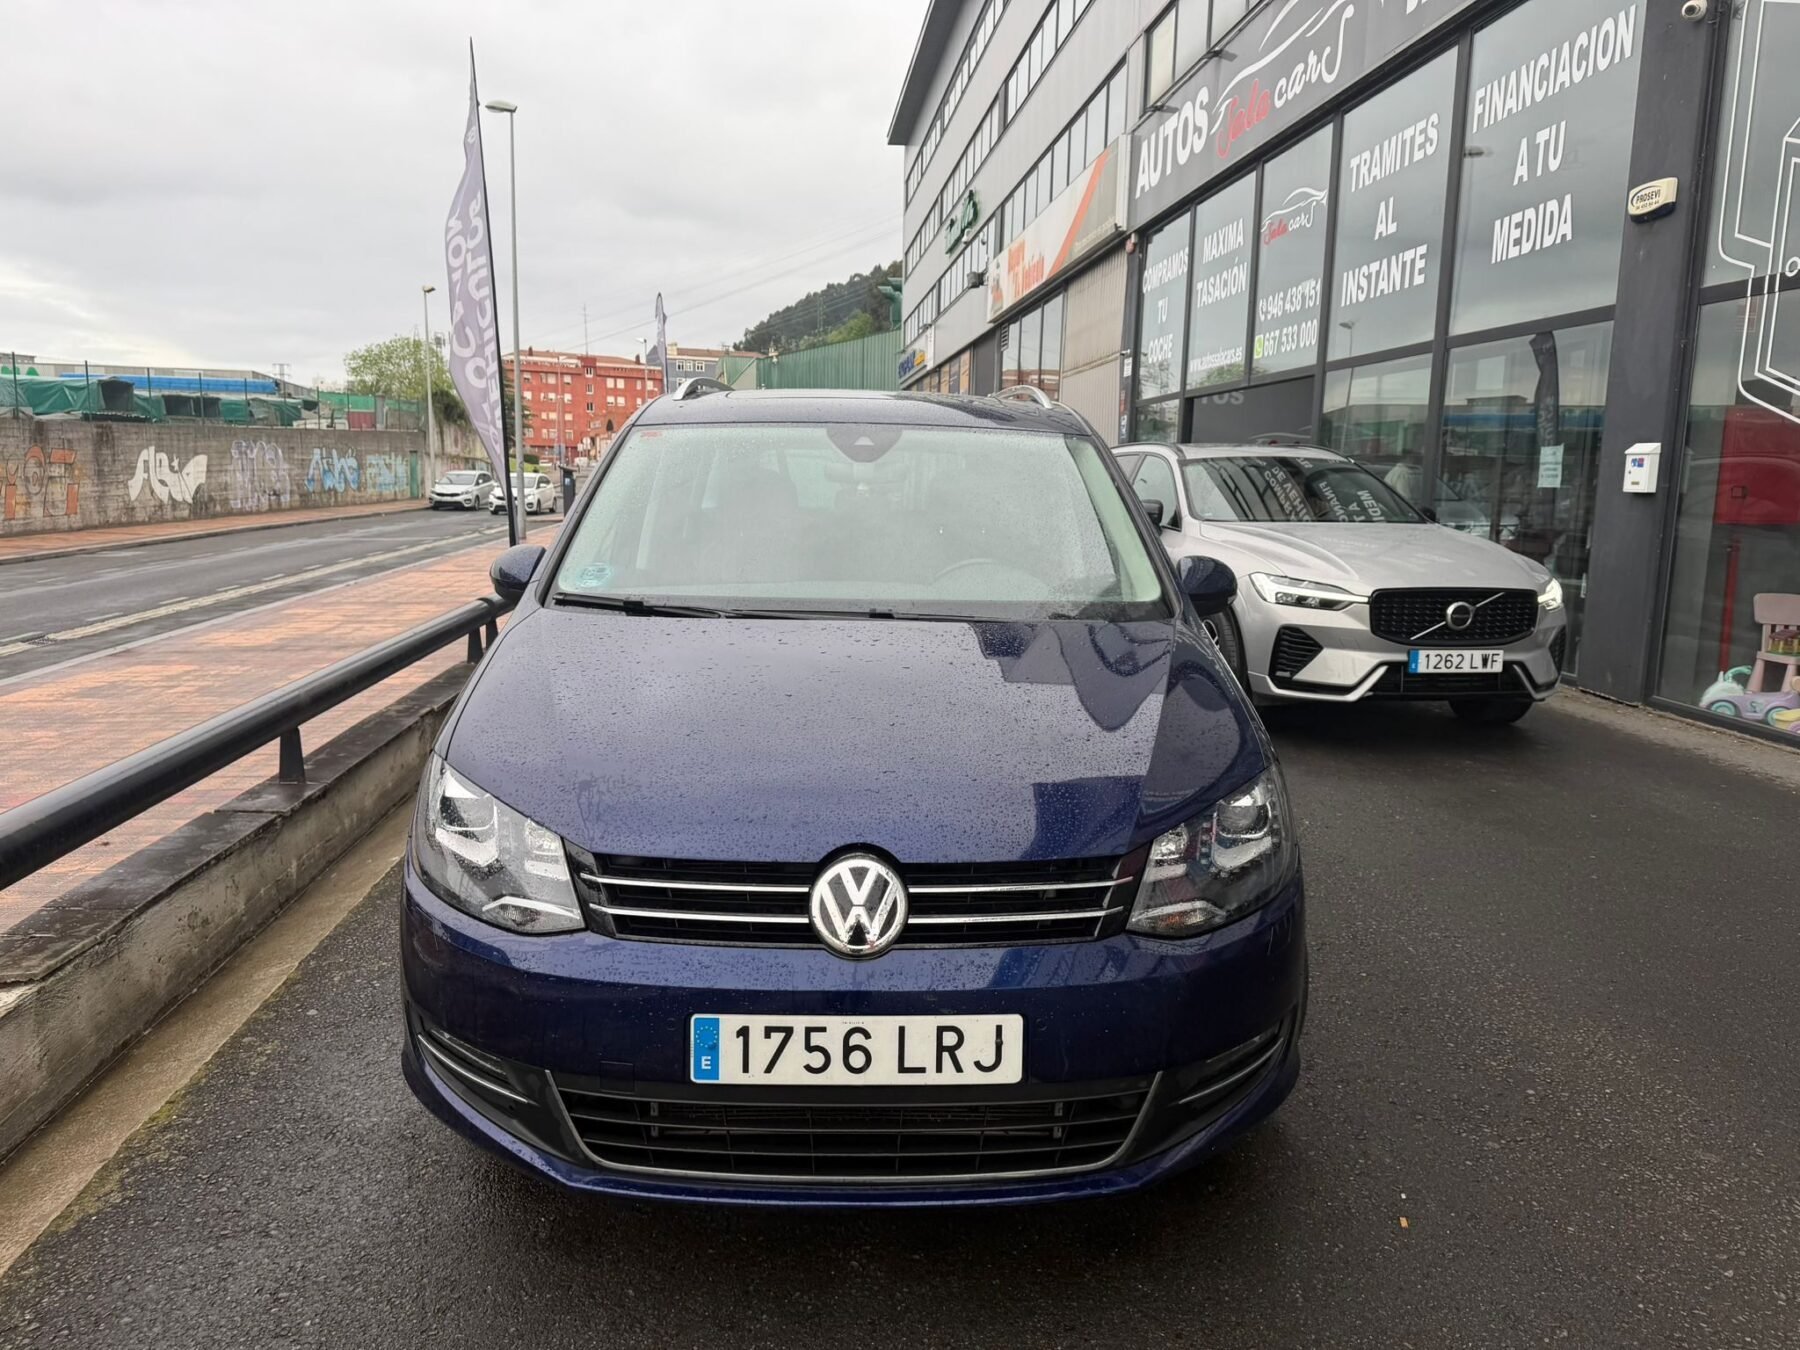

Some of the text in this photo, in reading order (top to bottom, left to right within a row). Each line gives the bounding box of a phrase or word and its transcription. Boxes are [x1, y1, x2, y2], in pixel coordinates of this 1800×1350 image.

[1472, 4, 1637, 134] FINANCIACION
[1135, 86, 1209, 199] AUTOS
[1350, 112, 1439, 192] TRAMITES
[1513, 120, 1566, 186] A TU
[1374, 196, 1397, 240] AL
[1635, 189, 1661, 204] PROSEVI
[1202, 217, 1244, 265] MAXIMA
[1491, 193, 1573, 265] MEDIDA
[1143, 247, 1189, 294] COMPRAMOS
[1196, 256, 1248, 308] TASACIÓN
[1341, 243, 1427, 307] INSTANTE
[1158, 296, 1168, 324] TU
[1267, 278, 1321, 320] 946 438 151
[1148, 333, 1173, 364] COCHE
[1263, 318, 1318, 357] 667 533 000
[1425, 653, 1500, 669] 1262 LWF
[701, 1056, 711, 1069] E
[735, 1024, 1004, 1075] 1756 LRJ
